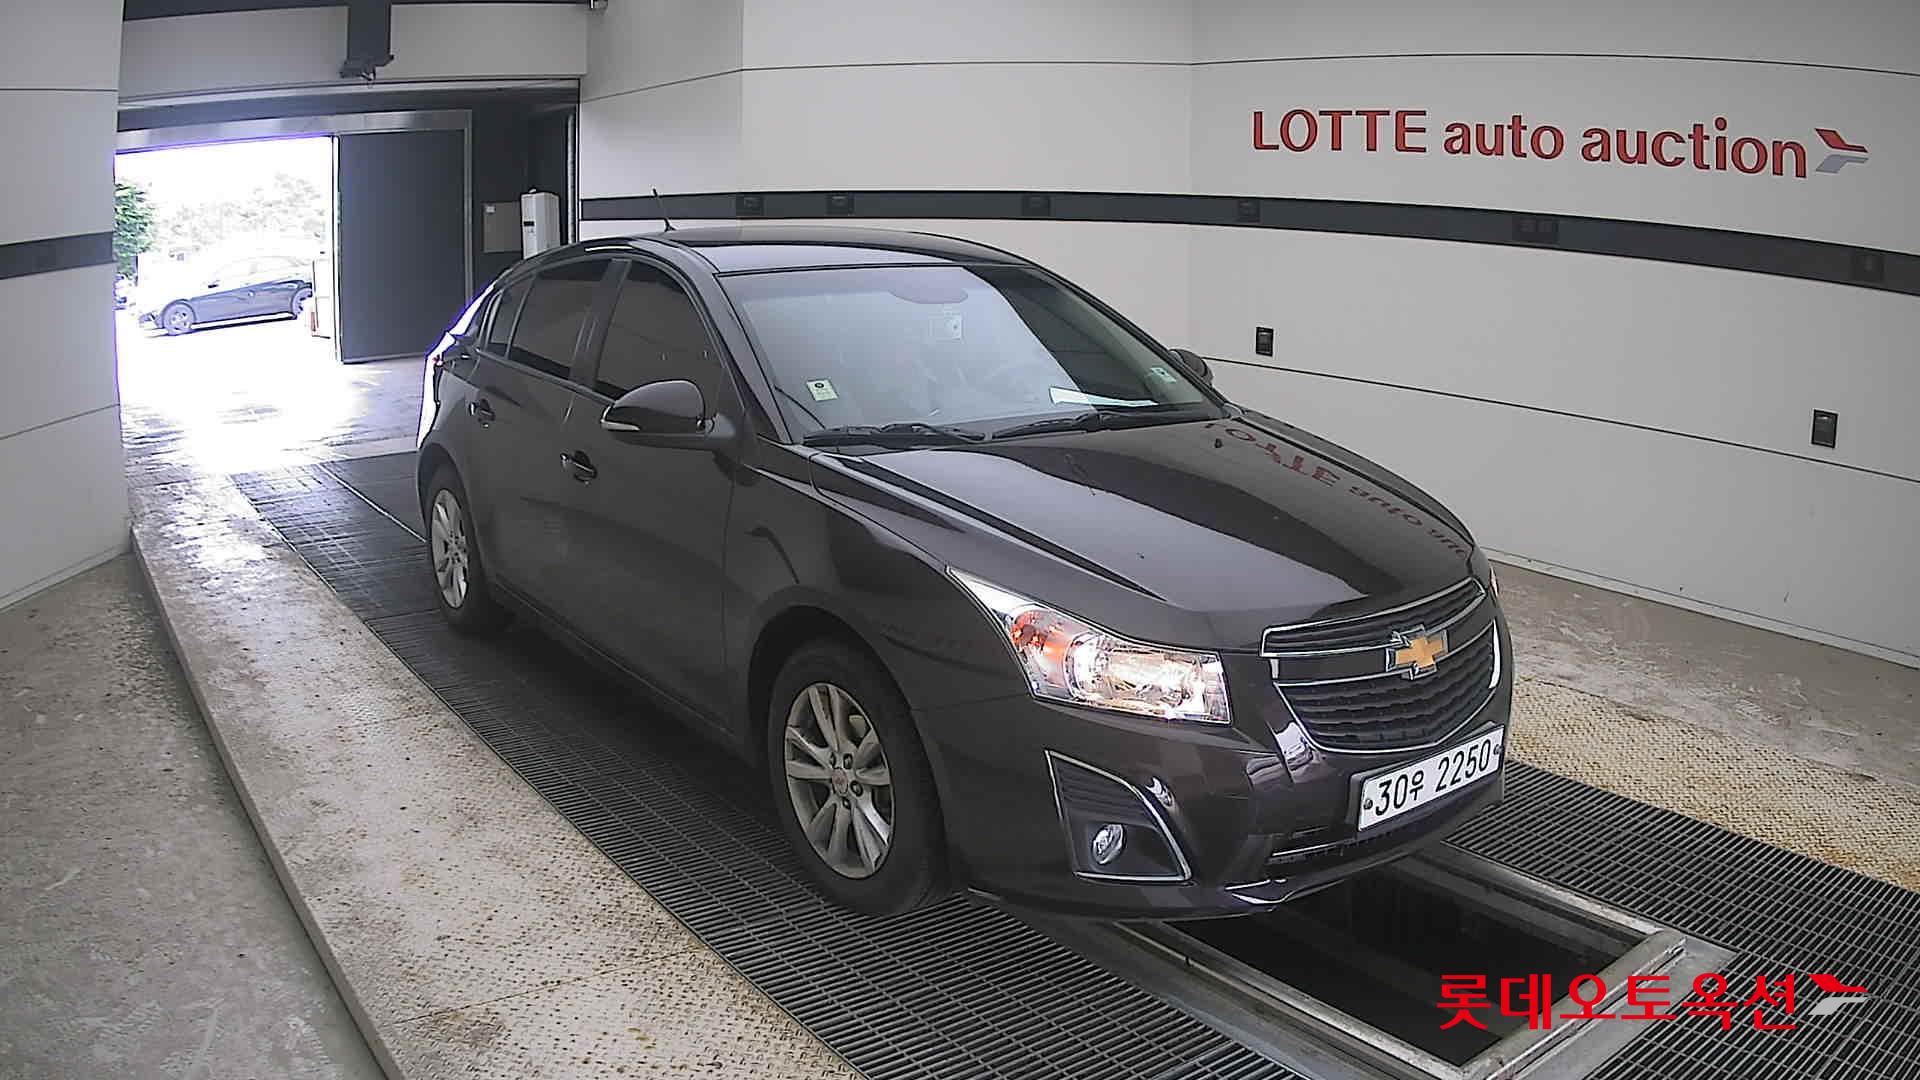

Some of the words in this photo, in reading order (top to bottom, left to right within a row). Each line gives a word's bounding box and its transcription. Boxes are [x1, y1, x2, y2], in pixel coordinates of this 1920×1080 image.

[1253, 110, 1427, 153] LOTTE
[1443, 115, 1566, 161] auto
[1581, 116, 1808, 178] auction
[1375, 769, 1424, 816] 30우
[1435, 738, 1491, 792] 2250
